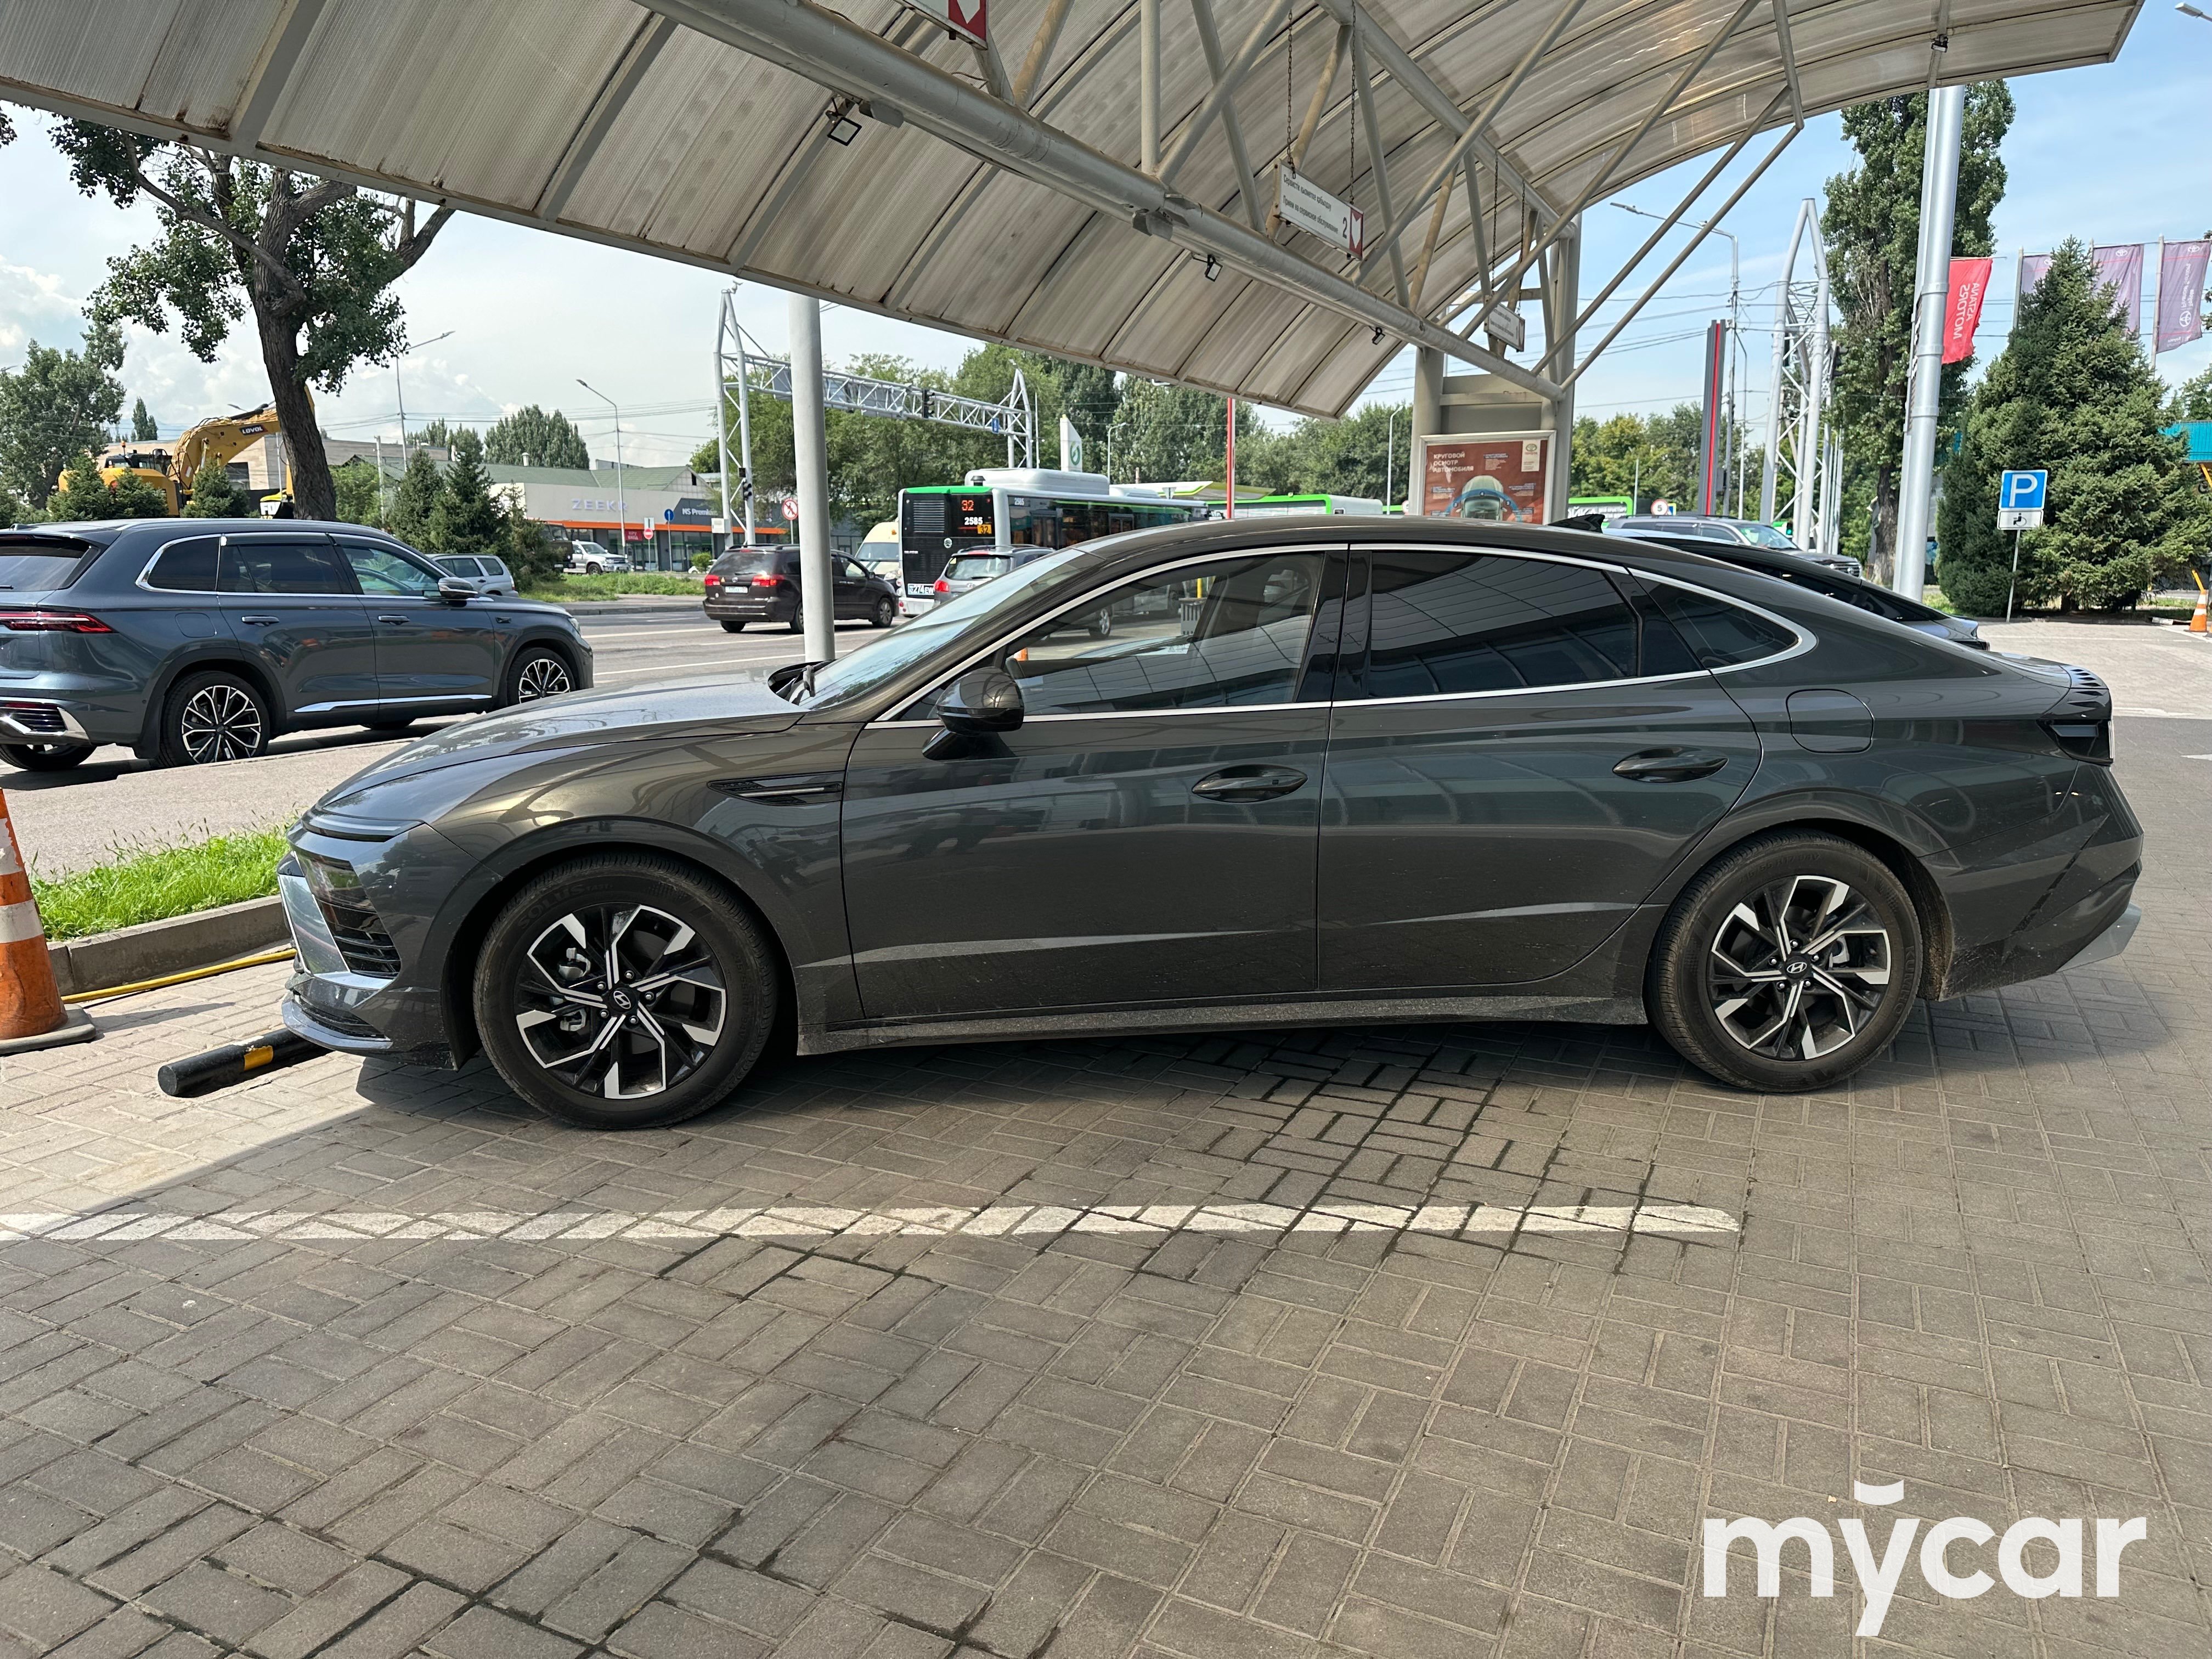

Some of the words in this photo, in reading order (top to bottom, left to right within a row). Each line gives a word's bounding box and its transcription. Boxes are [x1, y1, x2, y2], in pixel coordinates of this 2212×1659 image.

[1342, 216, 1348, 239] 2
[2009, 474, 2038, 507] P
[572, 499, 629, 511] ZEEKR
[961, 500, 974, 511] 32
[964, 517, 983, 526] 2585
[980, 526, 989, 534] 32
[1893, 945, 1915, 1014] KUMHO
